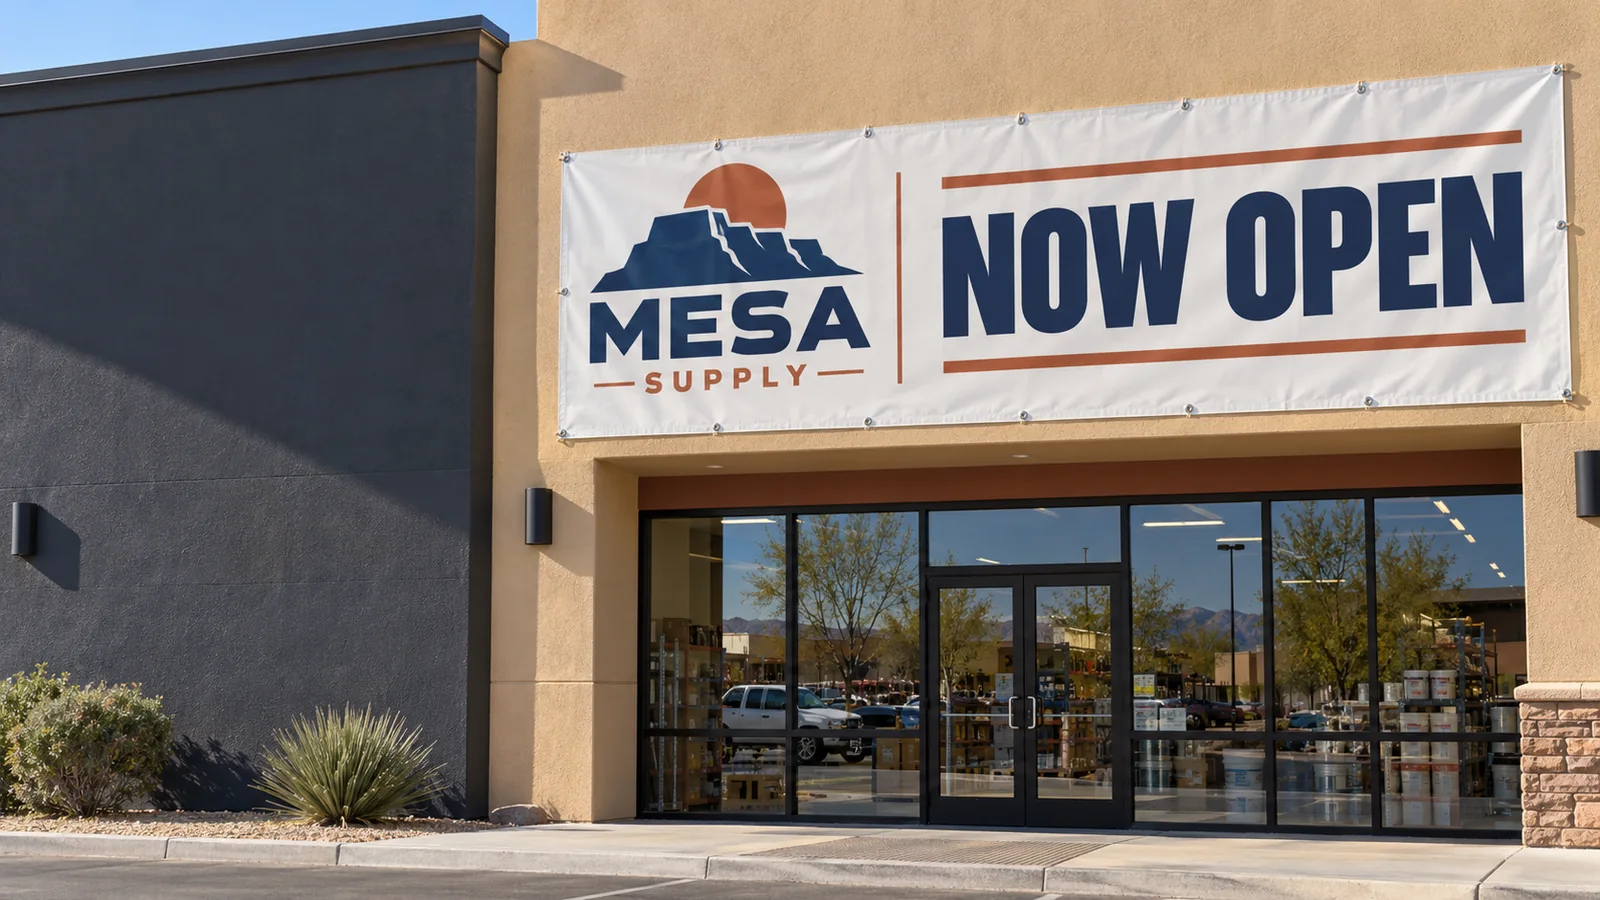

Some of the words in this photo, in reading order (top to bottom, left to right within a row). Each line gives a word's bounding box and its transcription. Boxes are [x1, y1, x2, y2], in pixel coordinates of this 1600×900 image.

[942, 199, 1194, 338] NOW
[1226, 171, 1524, 321] OPEN
[590, 286, 871, 363] MESA
[646, 364, 806, 394] SUPPLY
